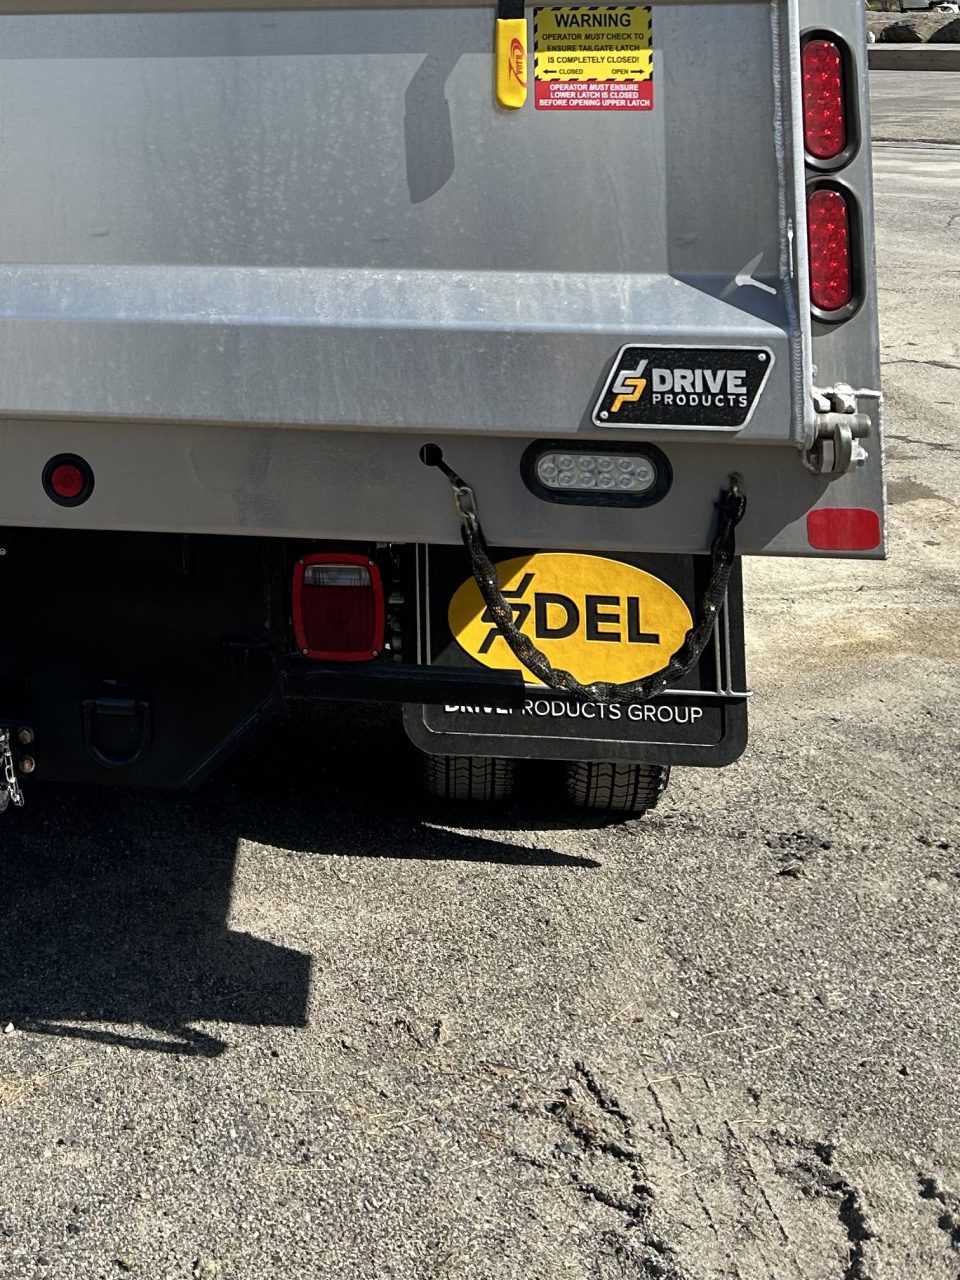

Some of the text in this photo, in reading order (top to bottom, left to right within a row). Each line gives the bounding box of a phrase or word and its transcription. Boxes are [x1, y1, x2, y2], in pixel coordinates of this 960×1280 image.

[554, 13, 631, 27] WARNING
[515, 54, 524, 75] VOTH
[652, 368, 747, 394] DRIVE
[652, 394, 748, 408] PRODUCTS
[534, 592, 660, 644] DEL
[627, 704, 703, 723] GROUP
